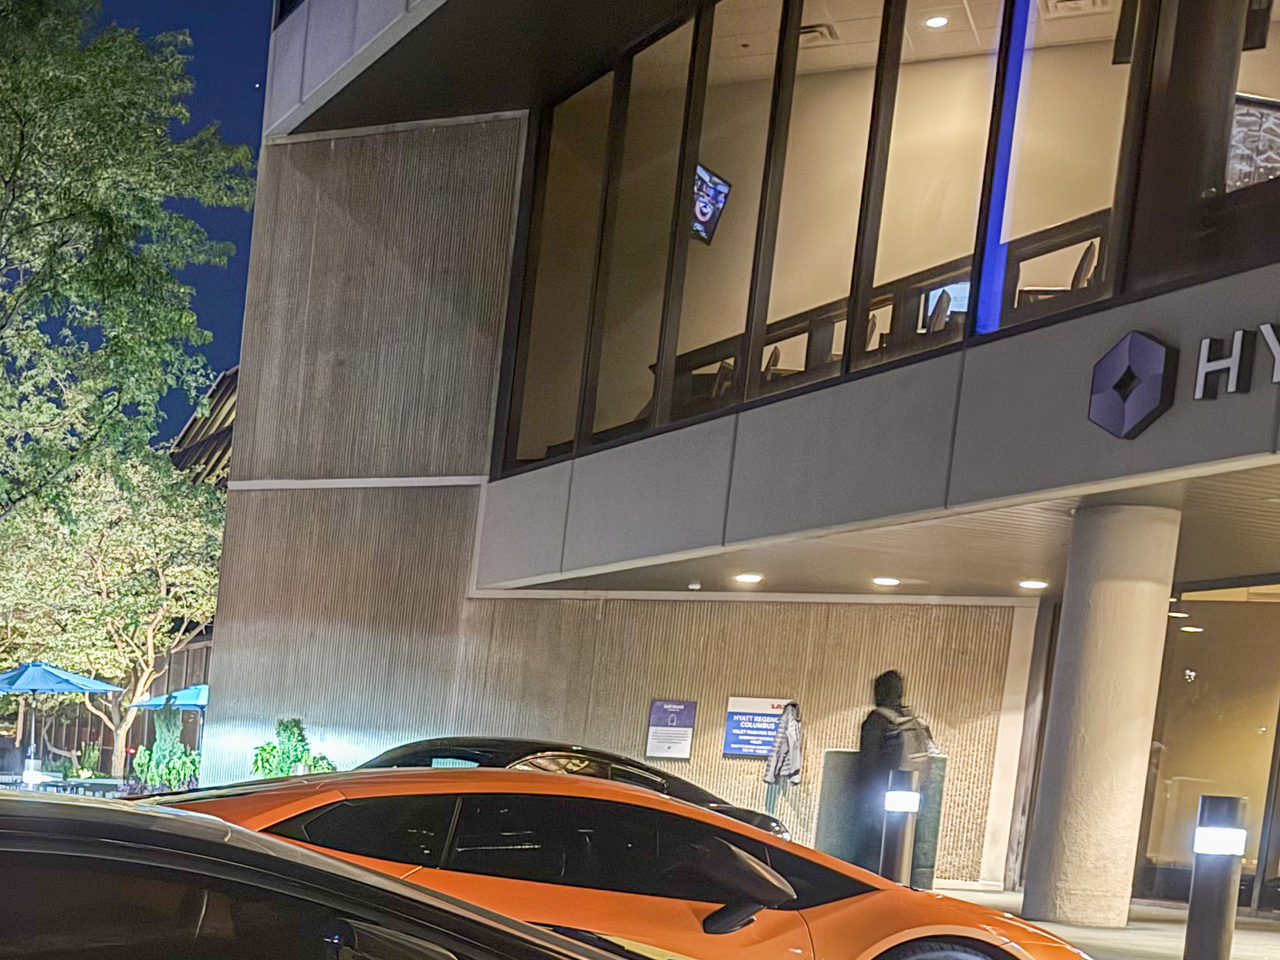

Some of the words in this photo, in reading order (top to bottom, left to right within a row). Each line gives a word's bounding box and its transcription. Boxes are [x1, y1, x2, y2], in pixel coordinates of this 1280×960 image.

[733, 714, 754, 722] HYATT
[754, 715, 780, 723] REGENC
[740, 721, 776, 730] COLUMBUS
